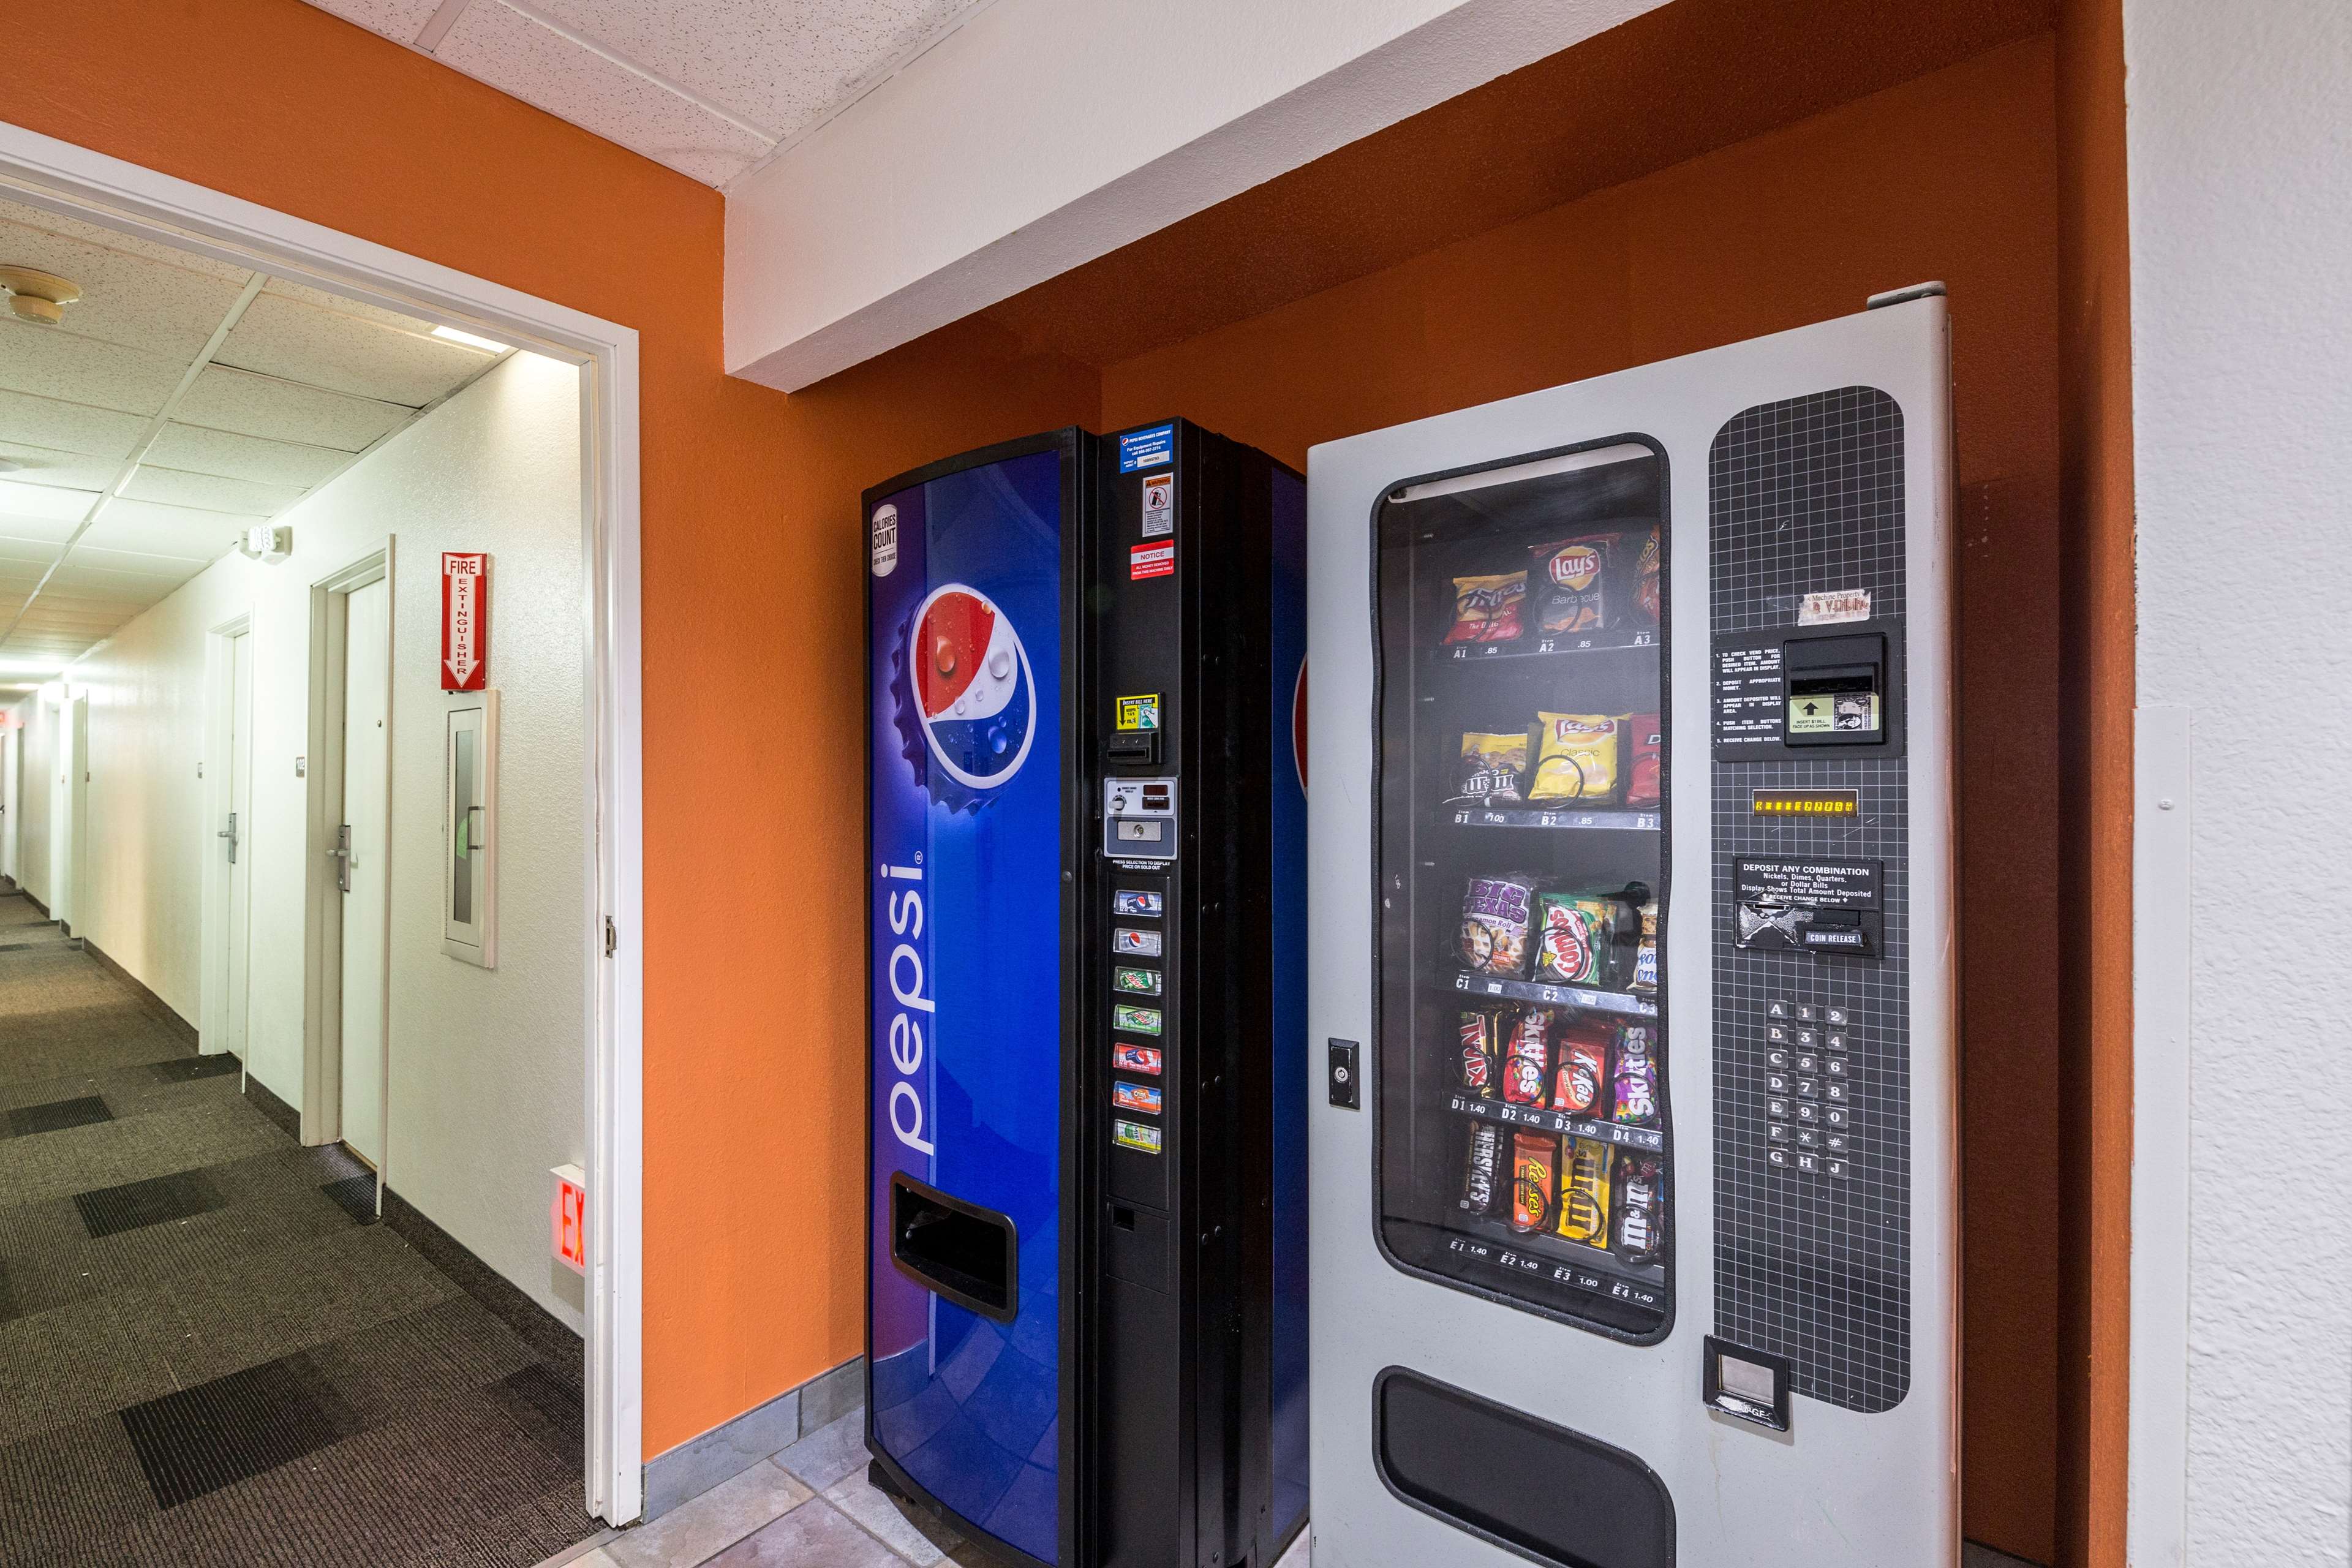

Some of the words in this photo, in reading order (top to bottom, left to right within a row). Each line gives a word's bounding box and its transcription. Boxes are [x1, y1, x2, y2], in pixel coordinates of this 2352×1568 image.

[874, 514, 895, 532] CALORIES
[1141, 551, 1164, 560] NOTICE
[451, 560, 476, 574] FIRE
[1556, 554, 1596, 581] Lay's
[457, 578, 467, 674] EXTINGUISHER
[1635, 636, 1650, 644] A3
[1539, 643, 1554, 652] A2
[1559, 748, 1600, 757] Classic
[1455, 815, 1468, 823] B1
[1542, 816, 1556, 826] B2
[1637, 818, 1654, 828] B3
[1803, 866, 1869, 876] COMBINATION
[1471, 880, 1525, 907] BIG
[1464, 897, 1527, 924] TEXAS
[1498, 920, 1511, 929] Roll
[1828, 935, 1856, 943] RELEASE
[1456, 979, 1469, 989] C1
[1544, 990, 1558, 1001] C2
[881, 864, 935, 1156] pepsi
[1640, 1002, 1656, 1014] C3
[1770, 1004, 1783, 1015] A
[1801, 1008, 1809, 1017] 1
[1830, 1011, 1840, 1021] 2
[1771, 1028, 1782, 1039] B
[1801, 1031, 1811, 1042] 3
[1830, 1036, 1840, 1047] 4
[1461, 1015, 1487, 1087] TWIX
[1770, 1054, 1782, 1064] C
[1801, 1058, 1810, 1068] 5
[1830, 1061, 1840, 1072] 6
[1770, 1077, 1782, 1088] D
[1801, 1082, 1810, 1092] 7
[1830, 1087, 1840, 1097] 8
[1452, 1099, 1464, 1110] D1
[1470, 1104, 1485, 1114] 1.40
[1771, 1102, 1782, 1113] E
[1801, 1107, 1811, 1117] 9
[1830, 1112, 1840, 1122] 0
[1502, 1109, 1516, 1120] D2
[1524, 1114, 1540, 1123] 1.40
[1555, 1118, 1570, 1131] D3
[1578, 1125, 1596, 1134] 1.40
[1771, 1127, 1782, 1137] F
[1613, 1129, 1629, 1143] D4
[1638, 1136, 1658, 1145] 1.40
[1770, 1152, 1783, 1163] G
[1800, 1158, 1812, 1168] H
[1830, 1163, 1840, 1173] J
[1450, 1241, 1464, 1251] E1
[1471, 1246, 1487, 1255] 1.40
[1501, 1255, 1517, 1265] E2
[1520, 1261, 1538, 1269] 1.40
[1554, 1270, 1570, 1280] E3
[1580, 1278, 1597, 1287] 1.00
[1612, 1286, 1629, 1297] E4
[1634, 1292, 1653, 1303] 1.40
